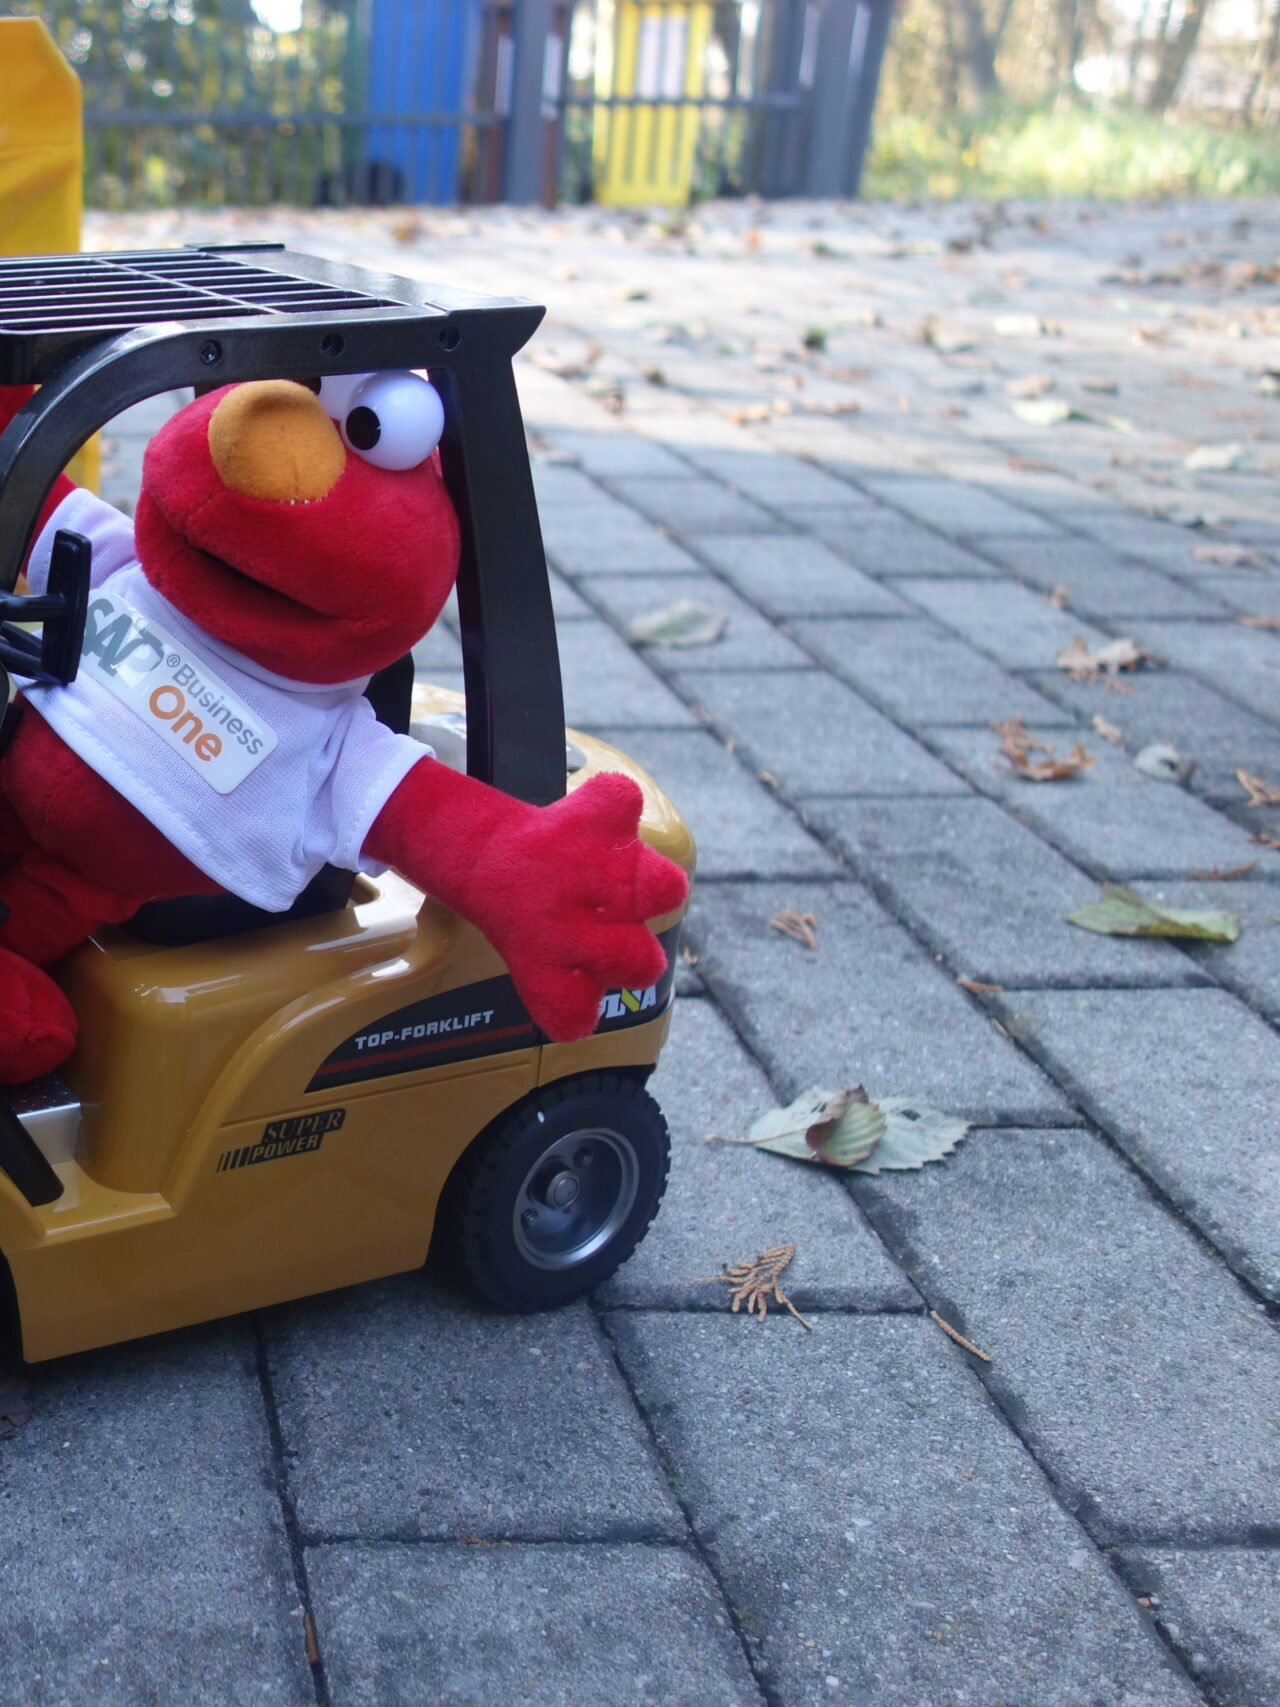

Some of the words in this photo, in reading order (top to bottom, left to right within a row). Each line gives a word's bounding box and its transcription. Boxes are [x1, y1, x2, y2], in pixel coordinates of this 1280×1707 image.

[81, 598, 165, 678] SAP
[148, 684, 223, 762] One
[171, 663, 265, 756] Business
[354, 1009, 495, 1051] TOP-FORKLIFT
[251, 1134, 320, 1162] POWER
[265, 1110, 342, 1141] SUPER
